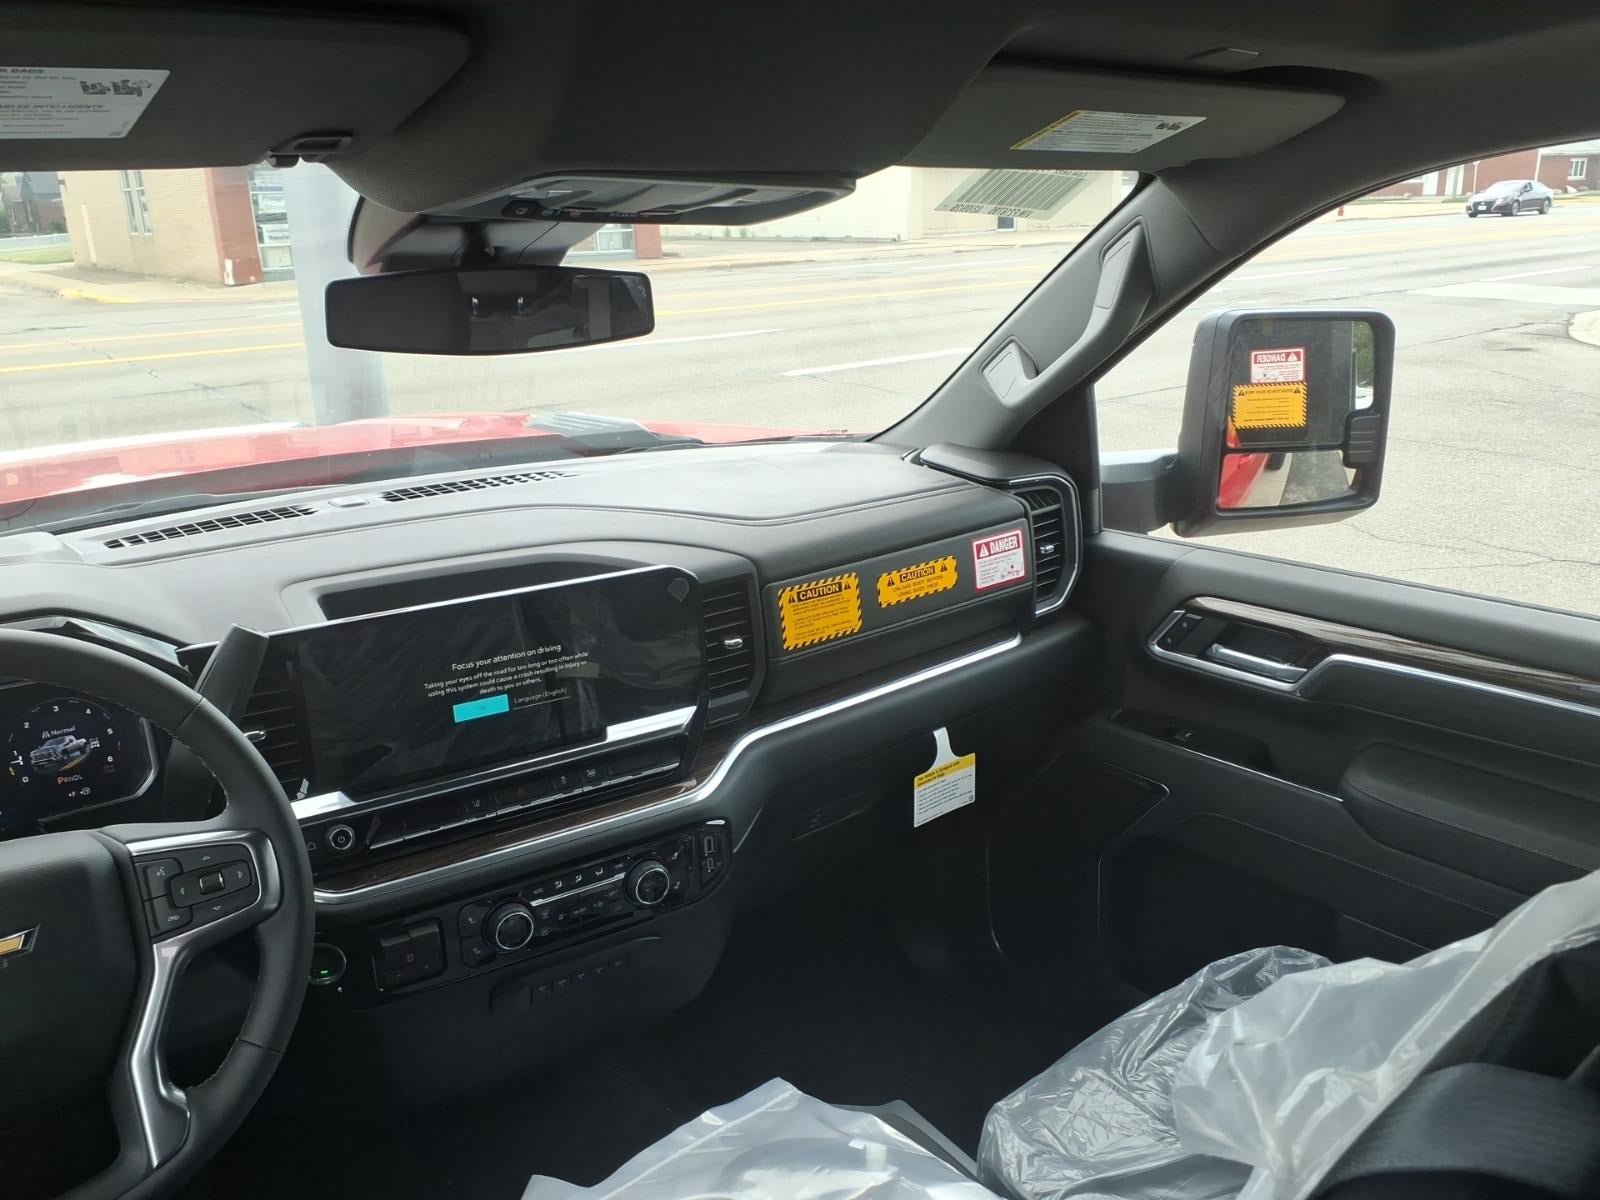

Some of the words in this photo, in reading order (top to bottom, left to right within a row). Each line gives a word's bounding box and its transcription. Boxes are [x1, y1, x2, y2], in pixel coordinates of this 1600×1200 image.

[990, 536, 1018, 554] DANGER
[901, 566, 934, 582] CAUTION
[800, 584, 839, 600] CAUTION
[452, 662, 474, 671] Focus
[475, 658, 492, 668] your
[493, 652, 526, 663] attention
[537, 645, 561, 655] driving
[424, 680, 444, 690] Taking
[445, 678, 458, 687] your
[459, 675, 472, 684] eyes
[528, 660, 541, 669] long
[558, 655, 573, 663] often
[574, 652, 588, 660] while
[428, 688, 445, 697] using
[458, 681, 478, 692] system
[479, 678, 495, 686] could
[496, 675, 512, 683] cause
[518, 670, 533, 679] crash
[534, 665, 558, 675] resulting
[565, 661, 580, 671] injury
[479, 686, 497, 695] death
[504, 682, 515, 692] you
[523, 678, 542, 687] others.
[514, 694, 542, 704] Language
[543, 688, 567, 698] (English)
[51, 725, 76, 735] Normal
